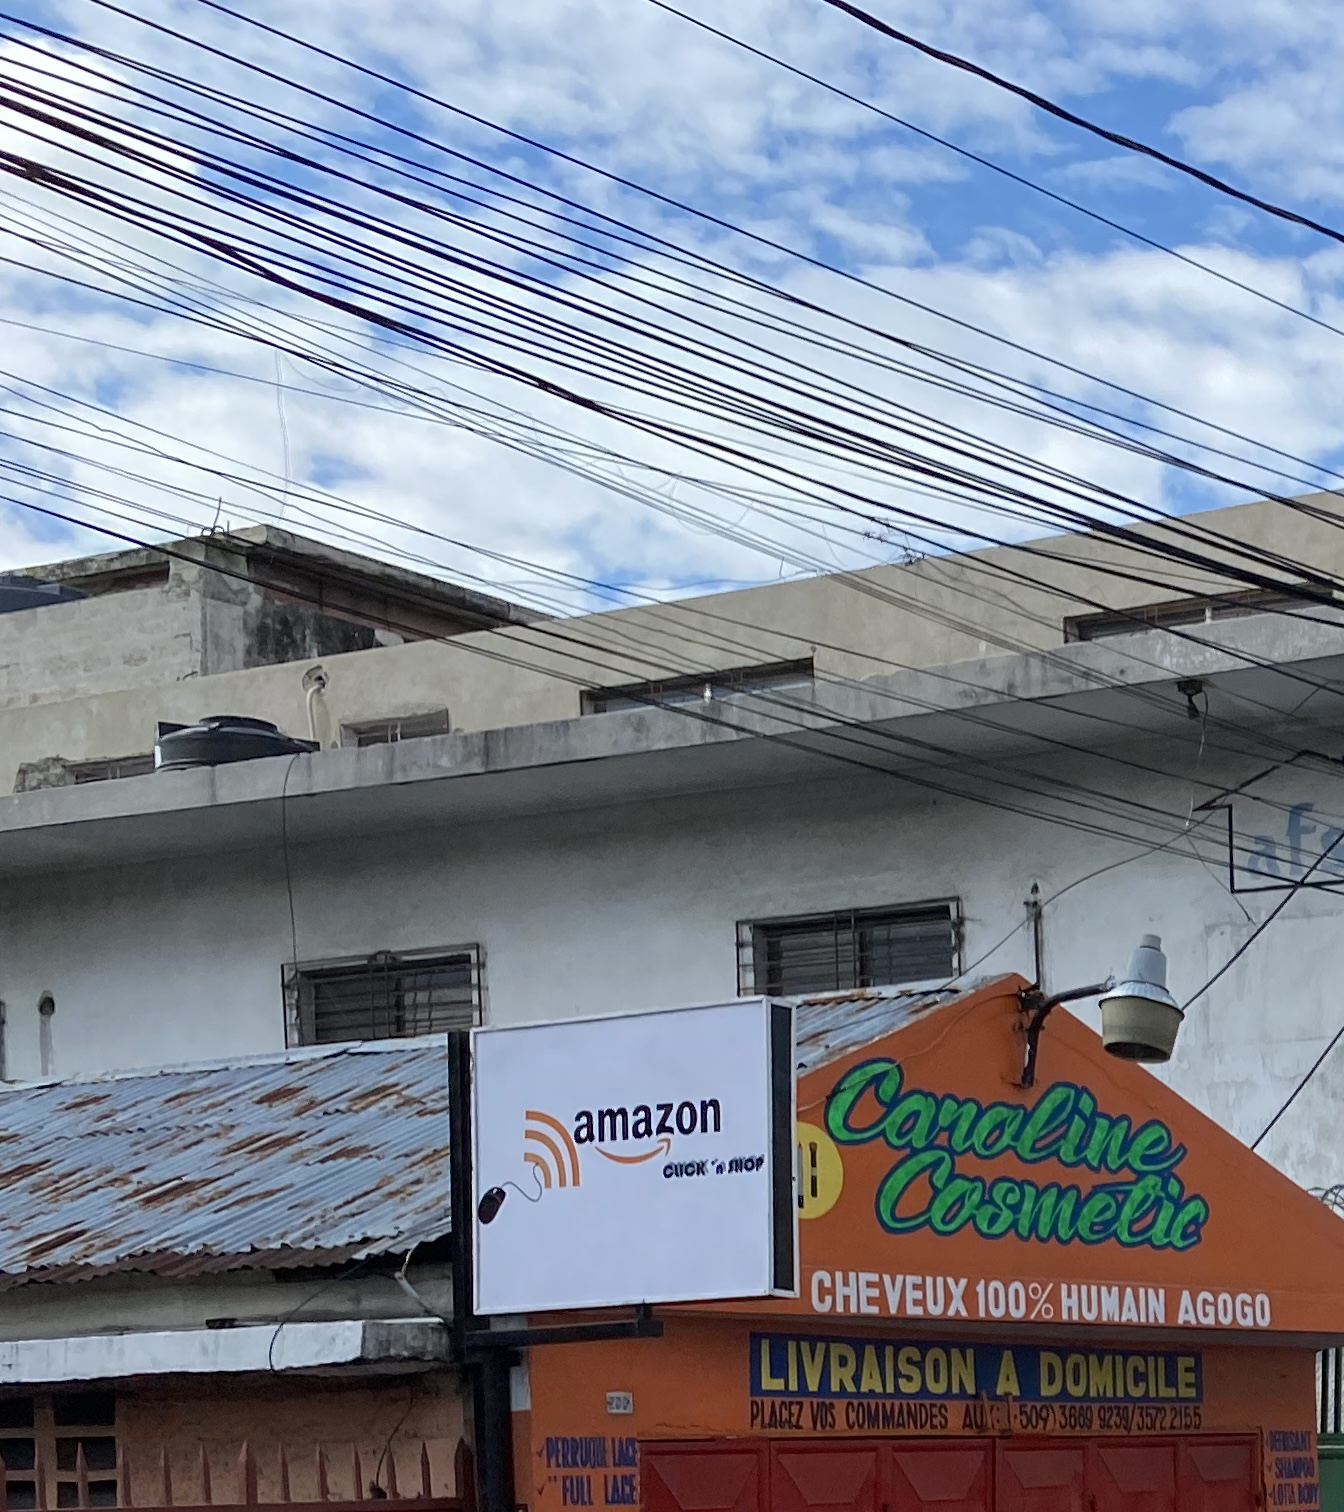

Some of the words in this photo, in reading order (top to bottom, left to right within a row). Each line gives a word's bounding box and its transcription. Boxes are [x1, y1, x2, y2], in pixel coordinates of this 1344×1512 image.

[574, 1098, 721, 1144] amazon
[825, 1057, 1187, 1174] Caroline
[663, 1159, 708, 1179] CLICK
[727, 1154, 764, 1174] SHOP
[875, 1149, 1209, 1252] Cosmetic
[811, 1269, 969, 1318] CHEVEUX
[976, 1279, 1055, 1321] 100%
[1061, 1283, 1165, 1325] HUMAIN
[1177, 1291, 1271, 1327] AGOGO
[761, 1338, 977, 1395] LIVRAISON
[996, 1350, 1020, 1397] A
[1039, 1350, 1197, 1399] DOMICILE
[750, 1401, 803, 1431] PLACEZ
[810, 1401, 837, 1431] VOS
[845, 1402, 949, 1431] COMMANDES
[562, 1476, 594, 1506] FULL
[604, 1474, 638, 1506] LACE
